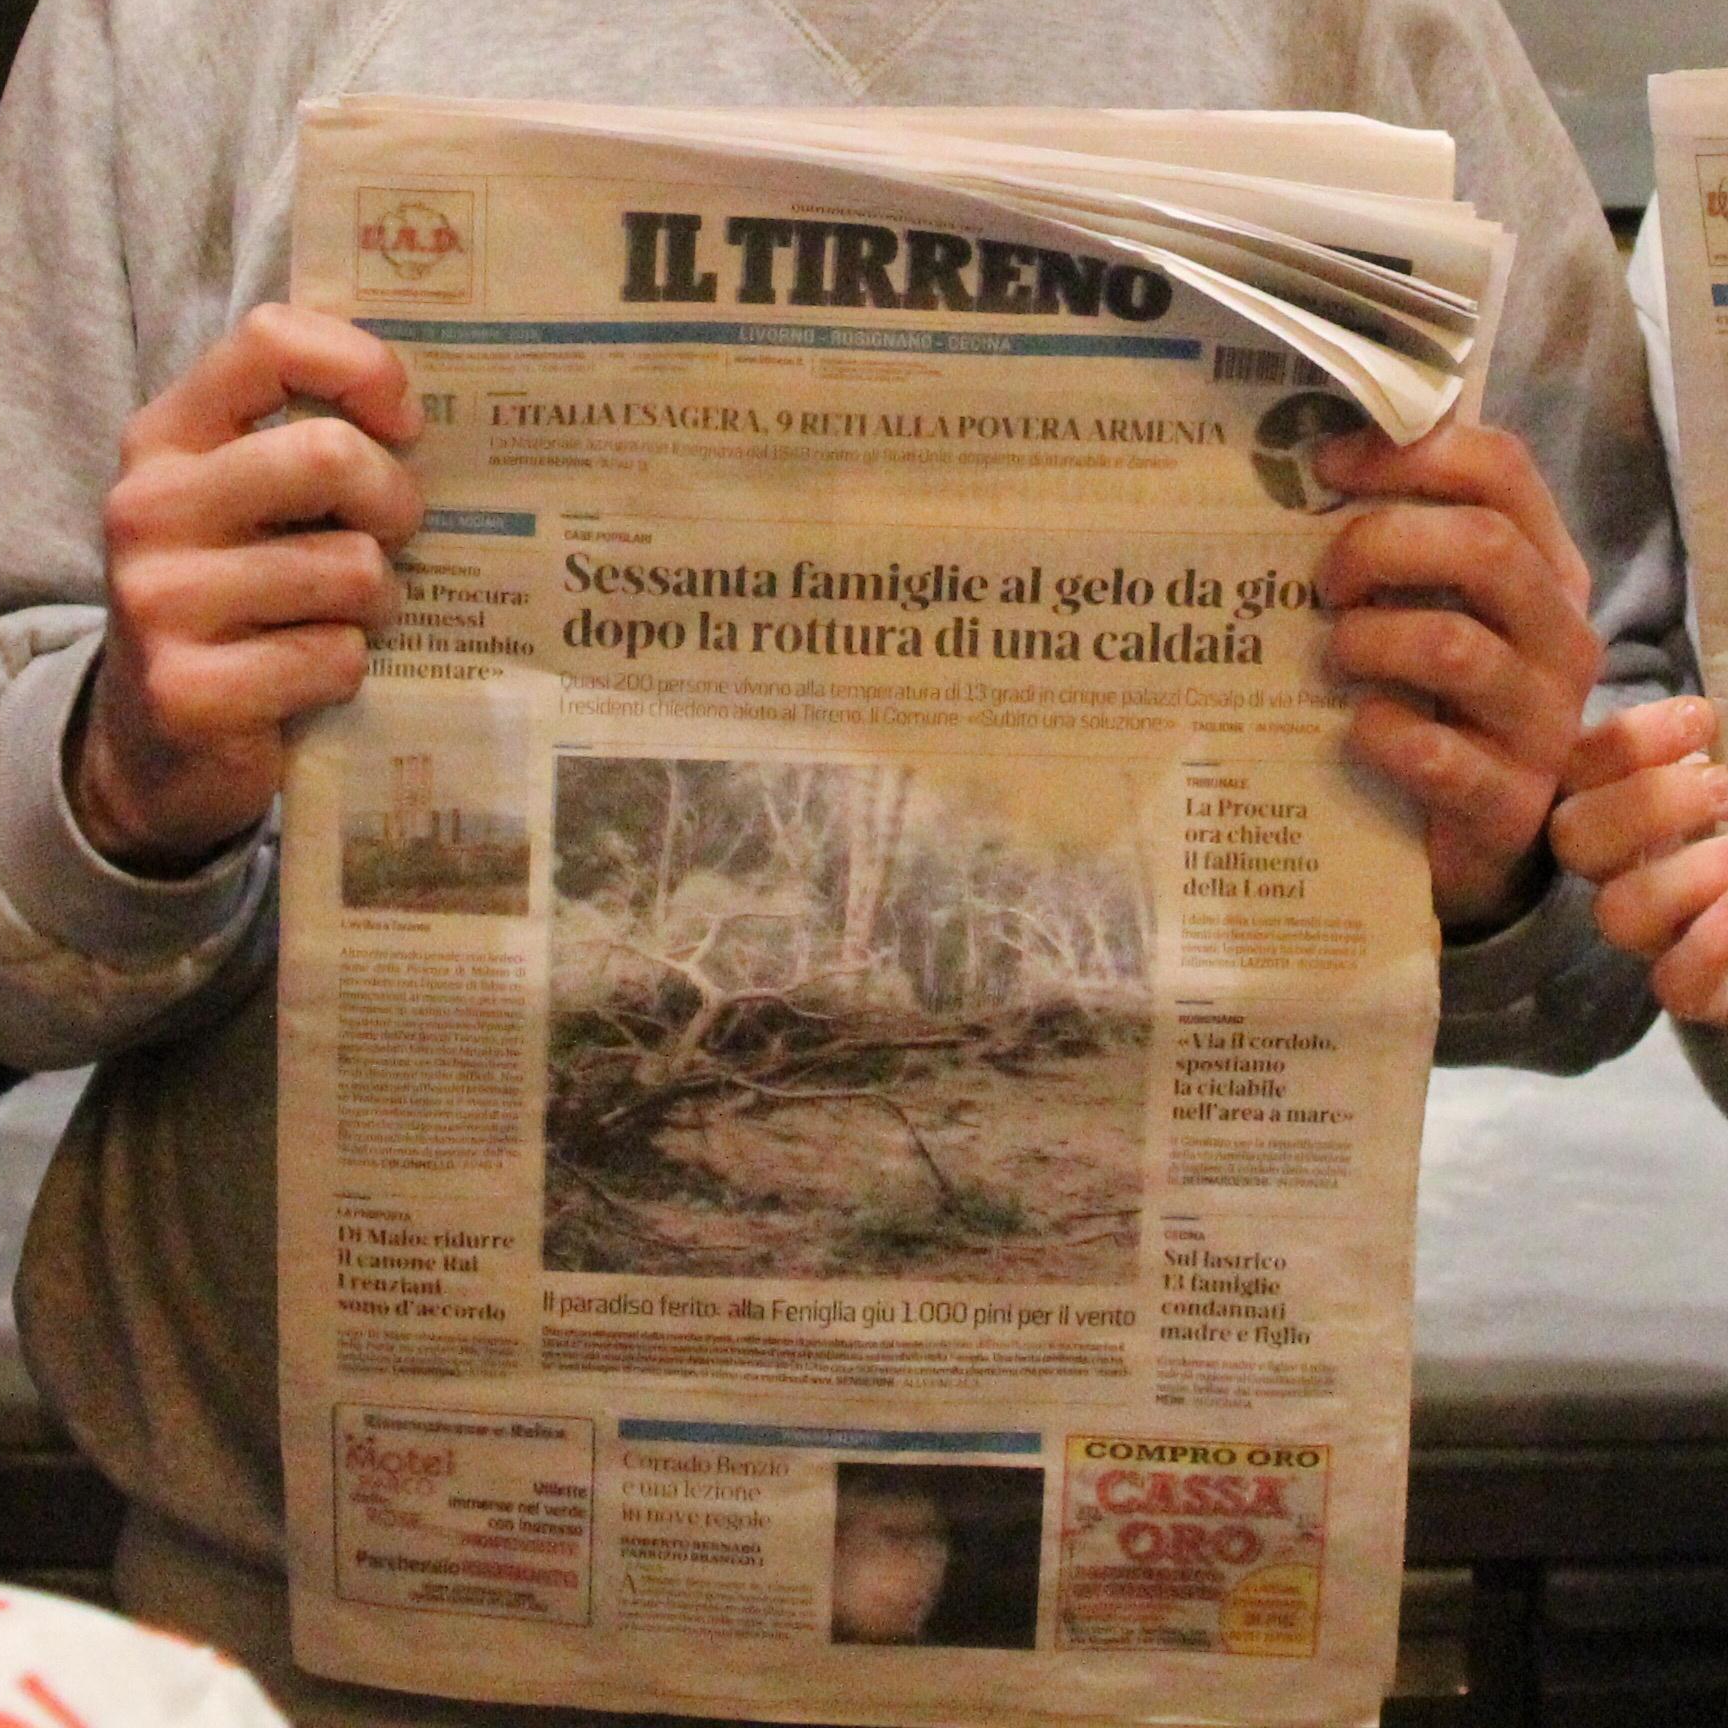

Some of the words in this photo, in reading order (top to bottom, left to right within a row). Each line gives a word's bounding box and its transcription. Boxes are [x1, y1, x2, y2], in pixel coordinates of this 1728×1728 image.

[623, 212, 717, 302] IL
[727, 217, 1174, 323] TIRRENO
[566, 554, 777, 598] Sessanta
[791, 562, 988, 610] famiglie
[1000, 567, 1041, 603] al
[1052, 568, 1154, 614] gelo
[1167, 569, 1222, 607] da
[563, 608, 685, 659] dopo
[700, 611, 736, 651] la
[753, 619, 921, 657] rottura
[935, 617, 979, 657] di
[994, 629, 1079, 660] una
[1093, 622, 1262, 664] caldaia
[1085, 1442, 1236, 1465] COMPRO
[1247, 1448, 1319, 1467] ORO
[1096, 1470, 1289, 1520] CASSA
[1118, 1522, 1264, 1570] ORO
